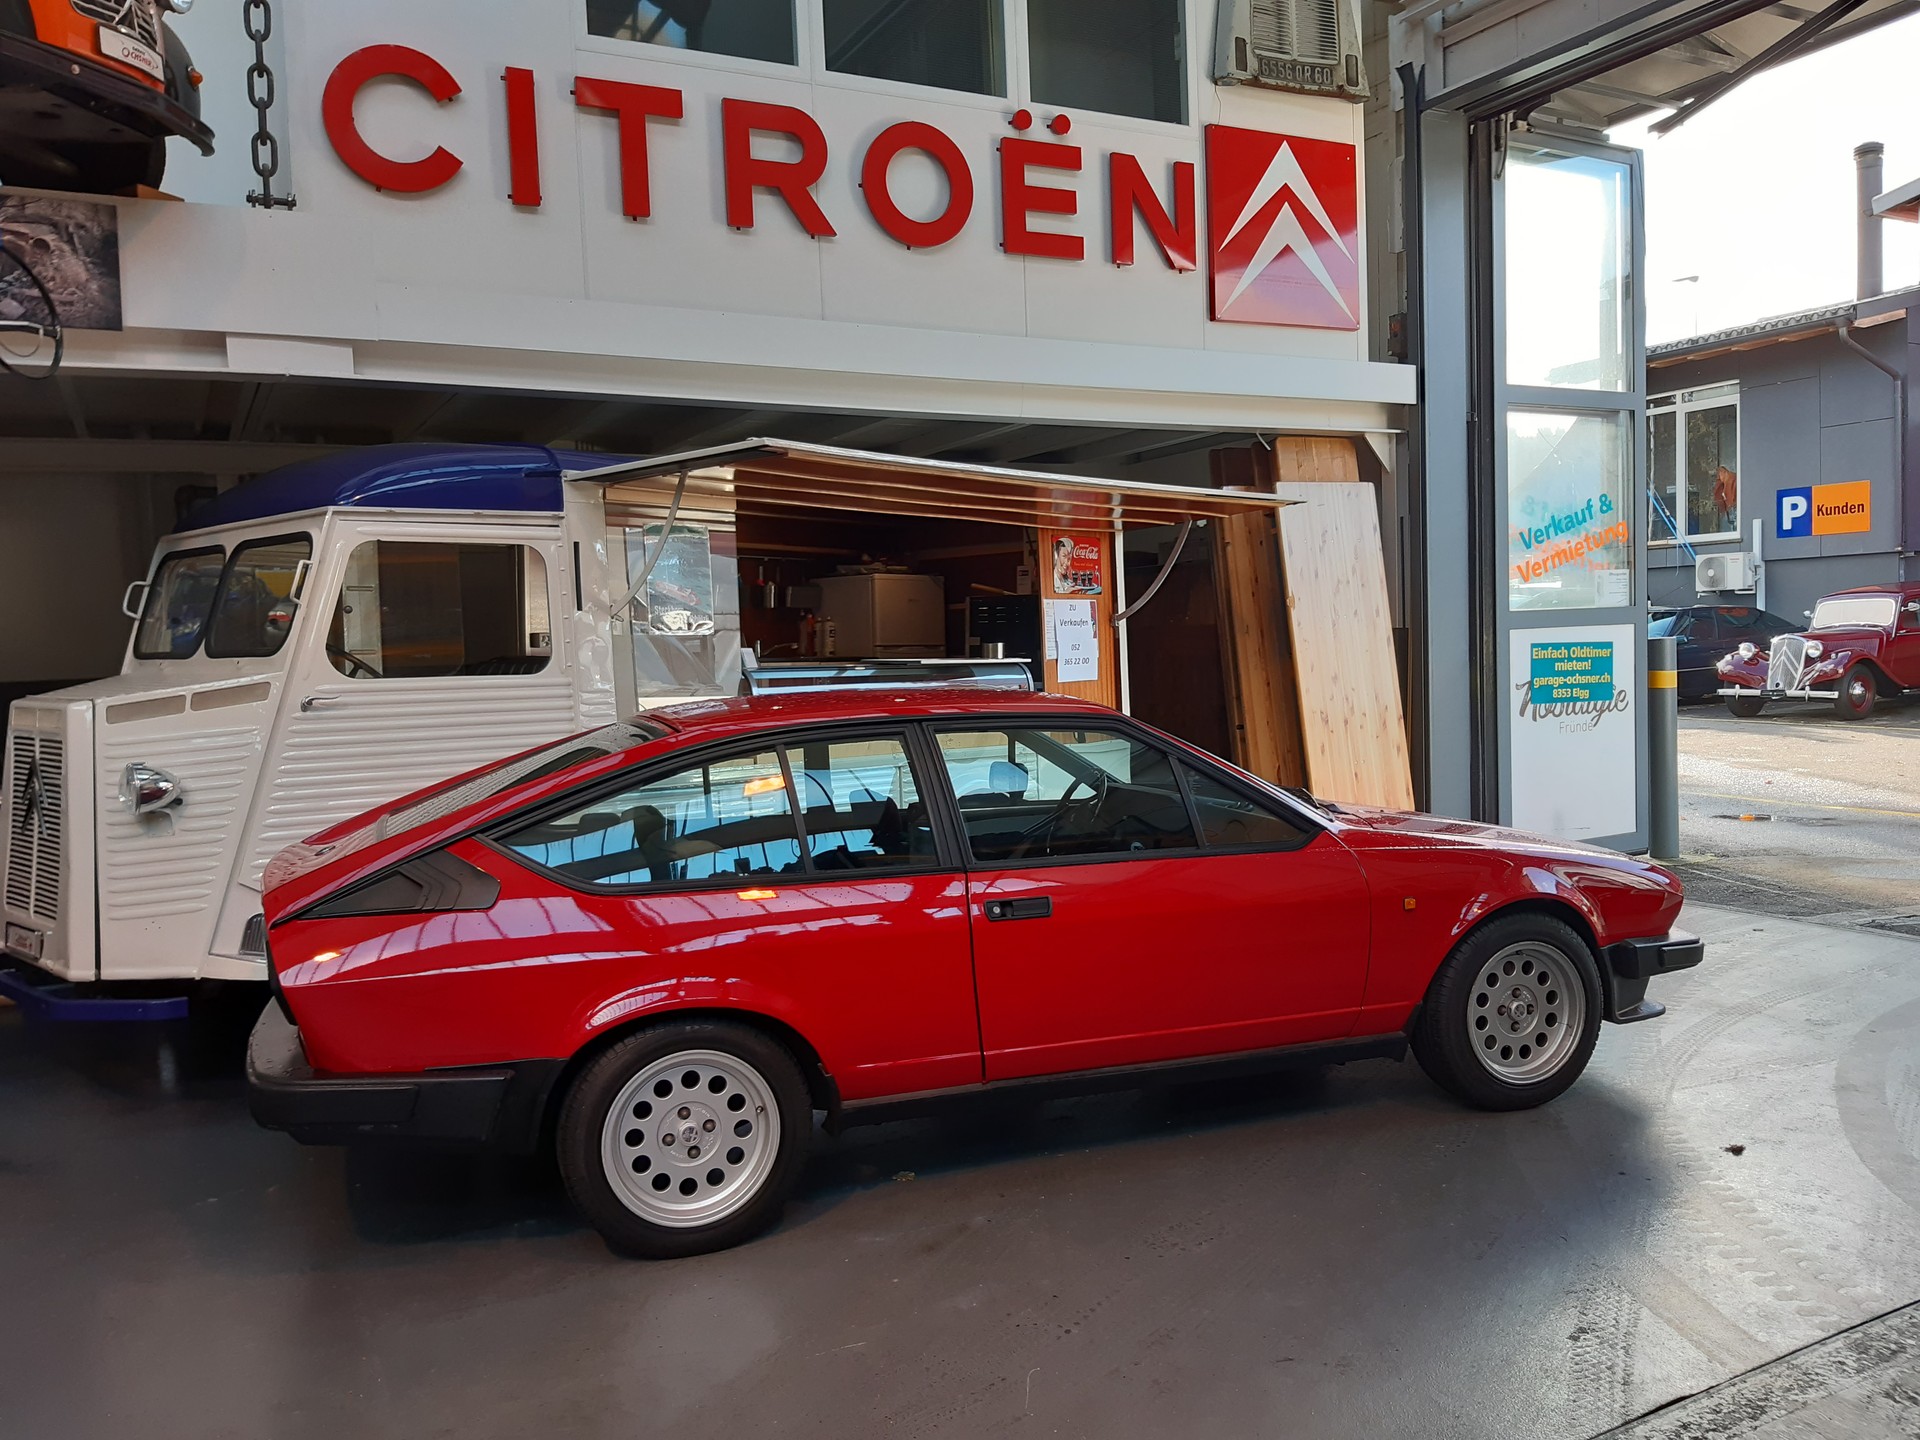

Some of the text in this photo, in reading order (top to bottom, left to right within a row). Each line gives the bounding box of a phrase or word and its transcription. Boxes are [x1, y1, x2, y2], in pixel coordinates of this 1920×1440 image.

[1315, 67, 1331, 84] 60
[322, 44, 1197, 272] CITROËN
[1782, 495, 1865, 531] P Kunden
[1518, 493, 1613, 550] Verkauf &
[1516, 520, 1629, 583] Vermietung
[1060, 618, 1089, 628] Verkaufen
[1071, 643, 1081, 651] 052
[1532, 645, 1612, 659] Einfach Oldtimer
[1064, 657, 1090, 666] 365 22 00
[1555, 659, 1592, 671] mieten!
[1533, 672, 1611, 688] garage-ochsner.ch
[1552, 688, 1590, 699] 8353 Elgg
[1559, 720, 1594, 734] Fründe
